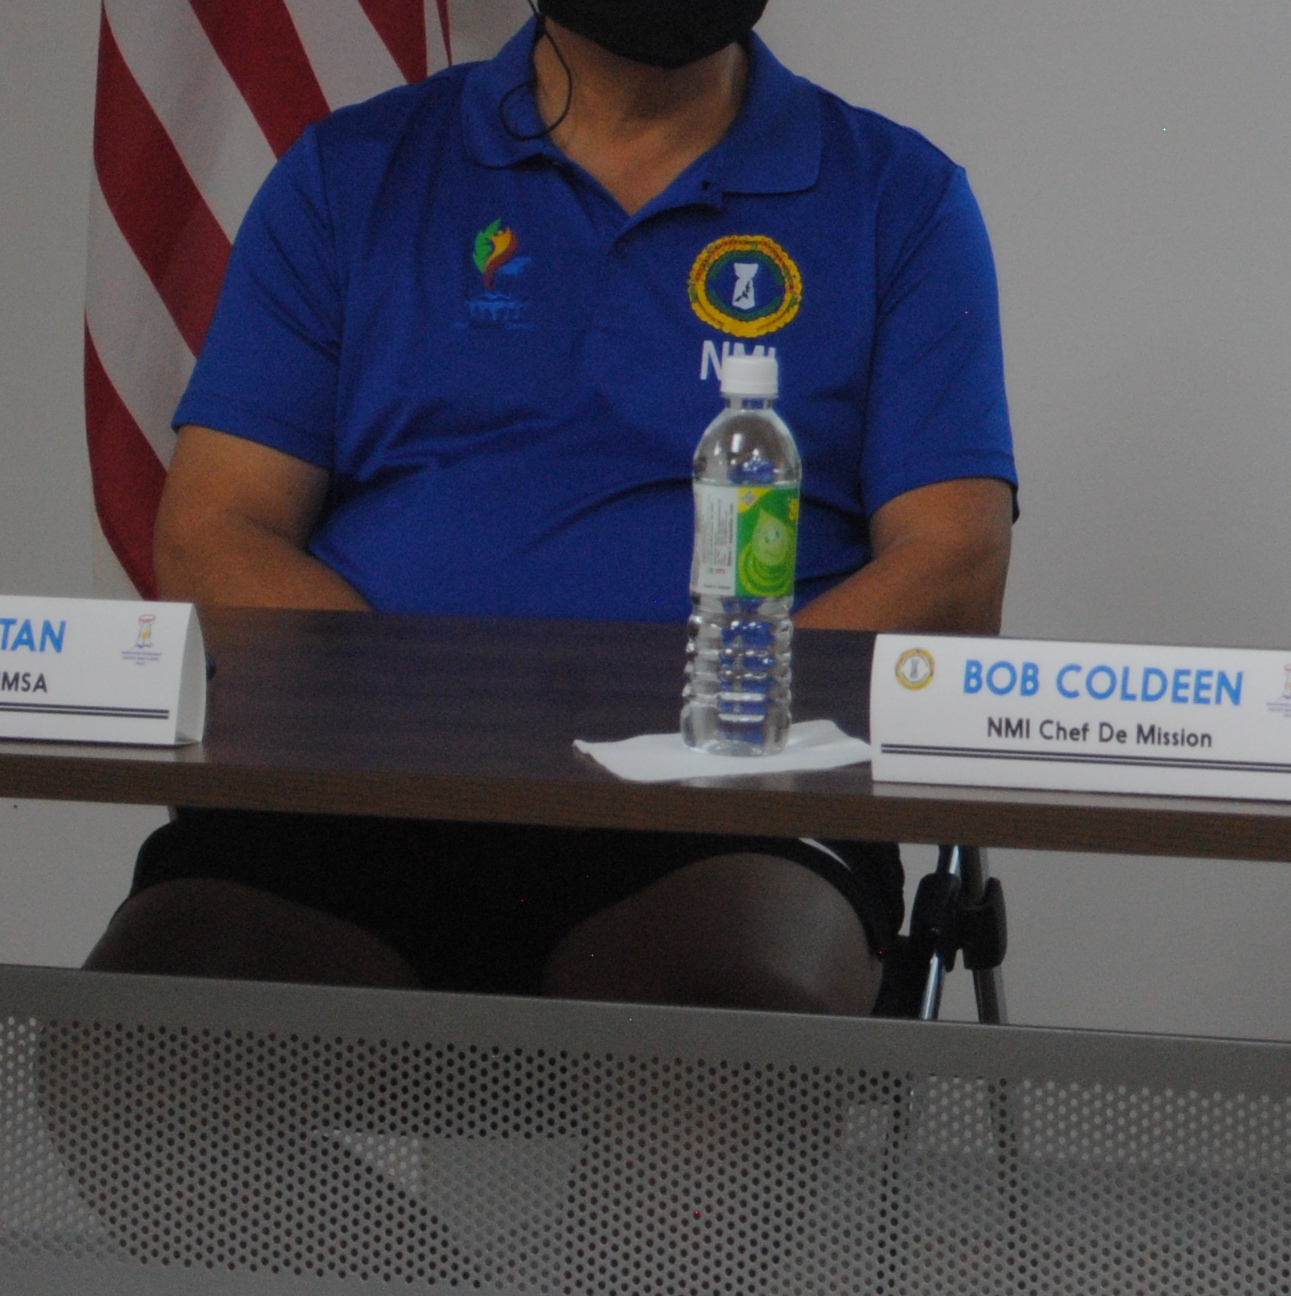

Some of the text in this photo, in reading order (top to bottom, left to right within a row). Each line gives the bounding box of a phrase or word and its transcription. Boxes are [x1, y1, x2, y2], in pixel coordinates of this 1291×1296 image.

[0, 617, 67, 653] TAN
[0, 670, 48, 693] MSA
[963, 659, 1244, 706] BOB COLDEEN
[986, 716, 1213, 748] NMI Chef De Mission
